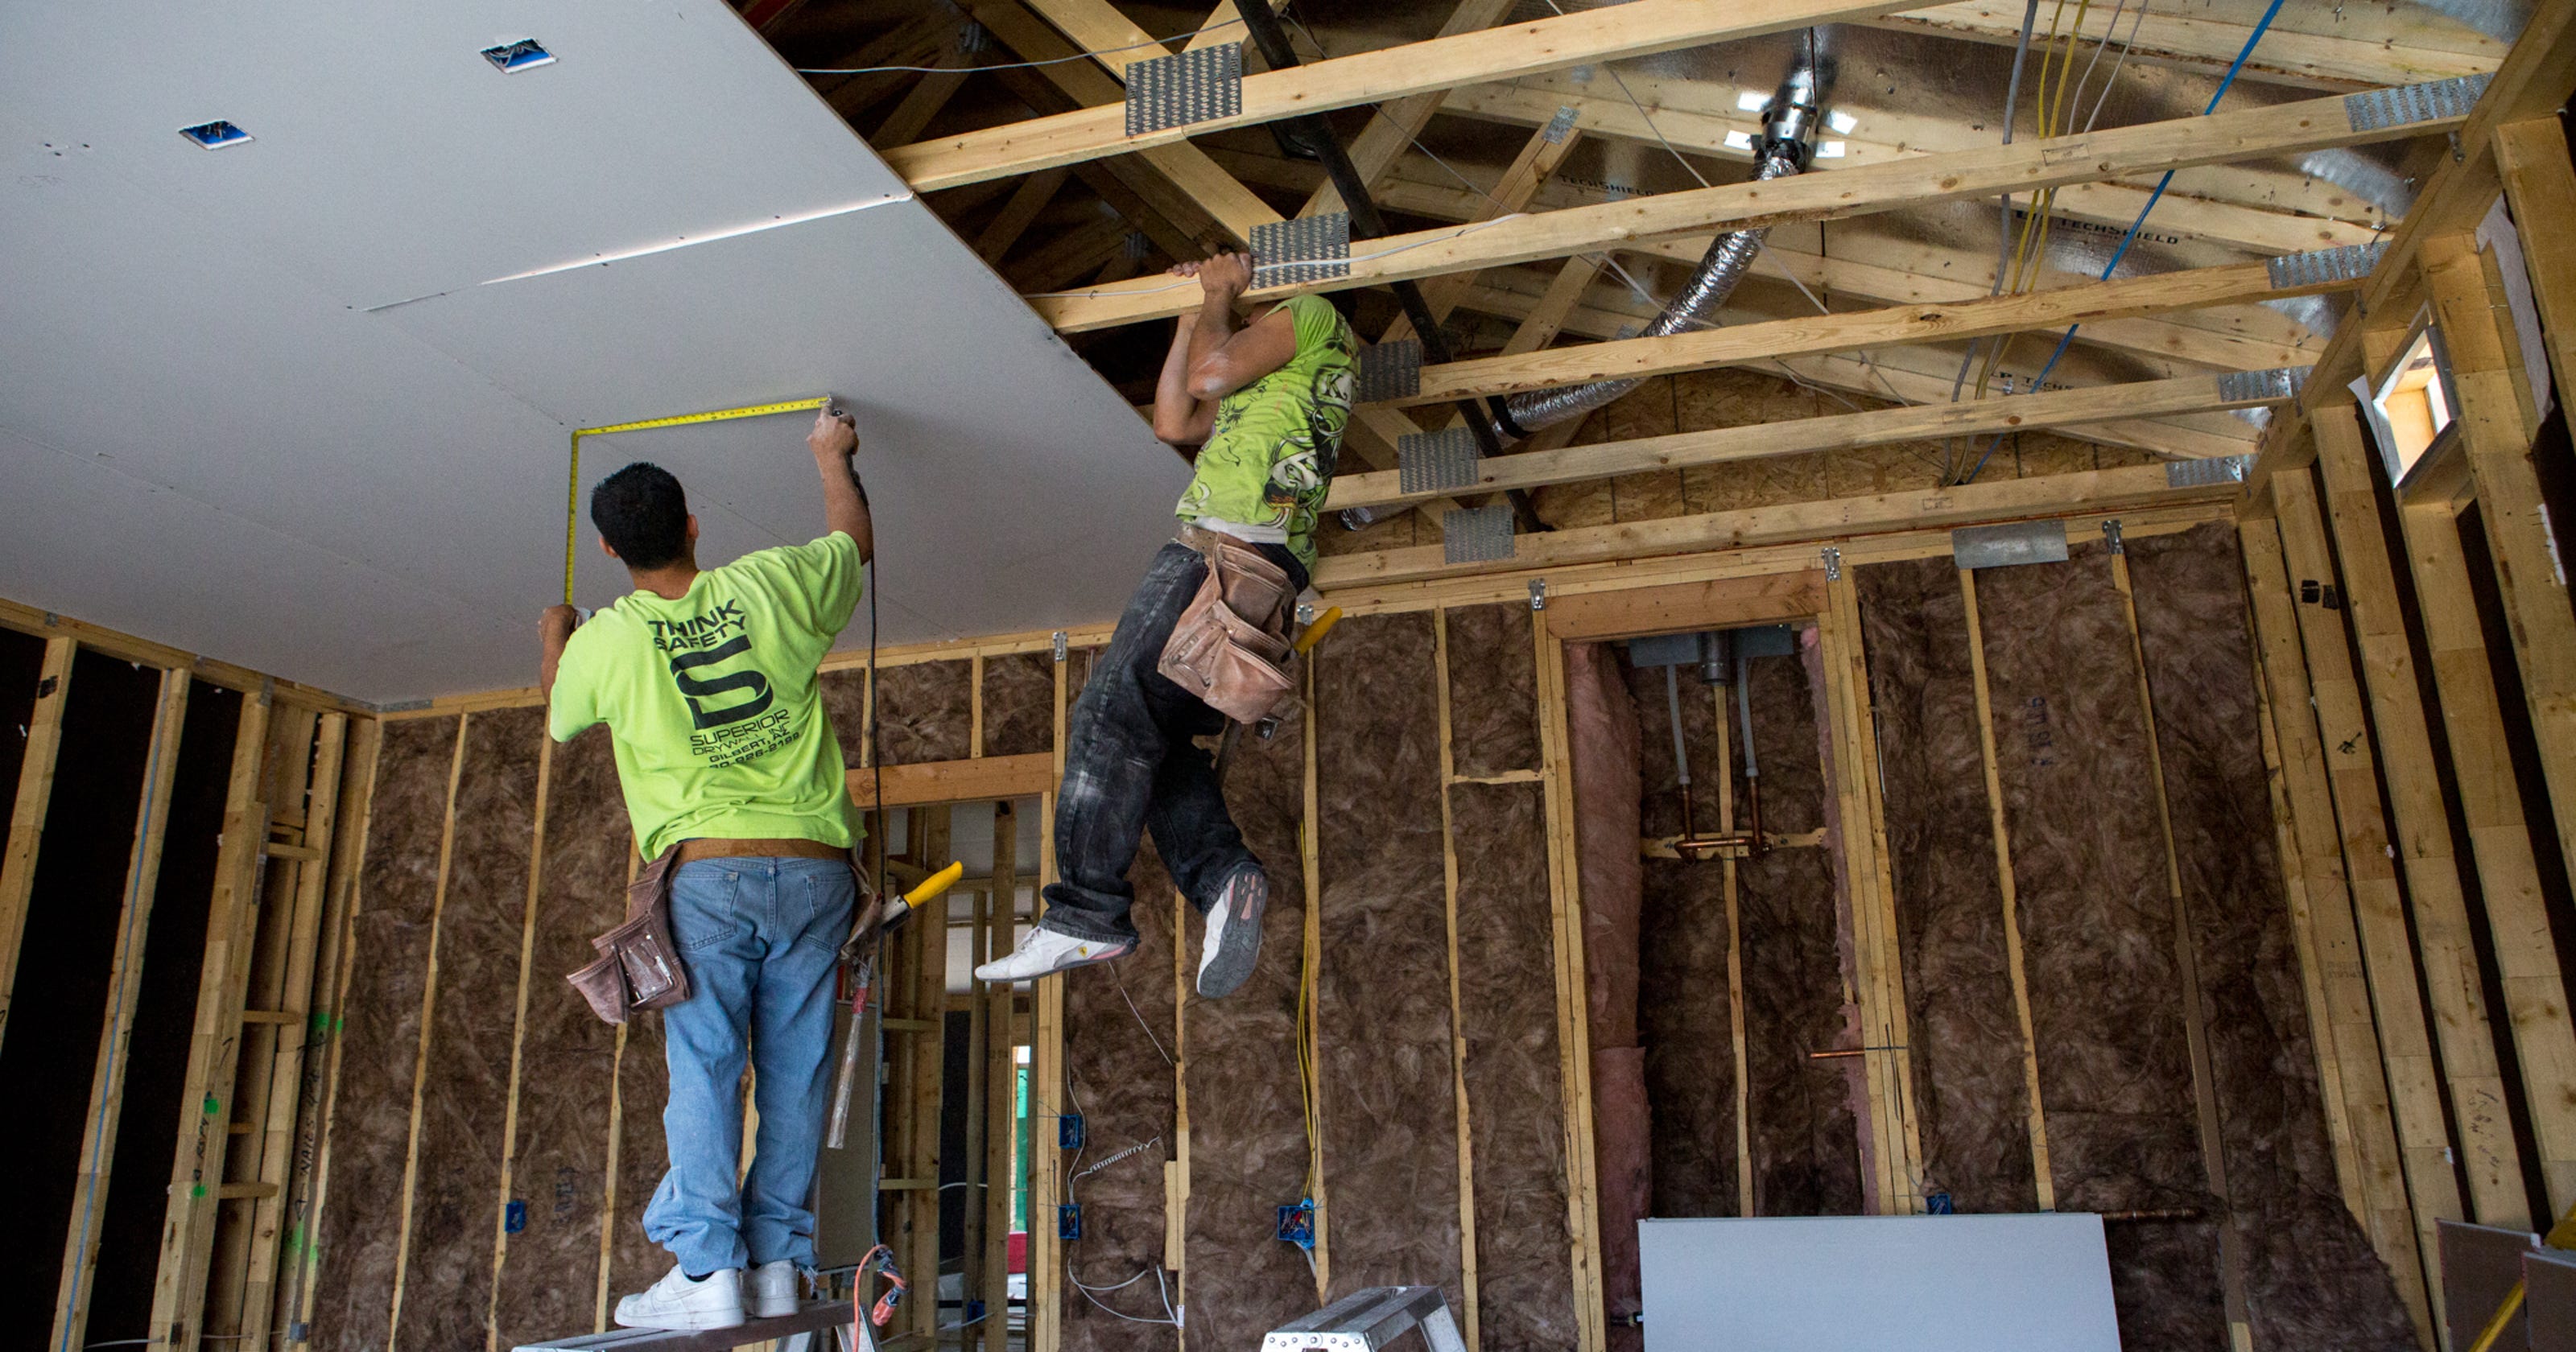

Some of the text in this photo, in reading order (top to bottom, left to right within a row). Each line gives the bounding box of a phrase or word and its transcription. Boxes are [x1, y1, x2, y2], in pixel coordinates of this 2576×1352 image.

[648, 598, 744, 638] THINK
[653, 615, 745, 652] SAFETY
[690, 709, 791, 747] SUPERIOR
[692, 733, 759, 756] DRYW
[708, 737, 771, 763] GILBERT,
